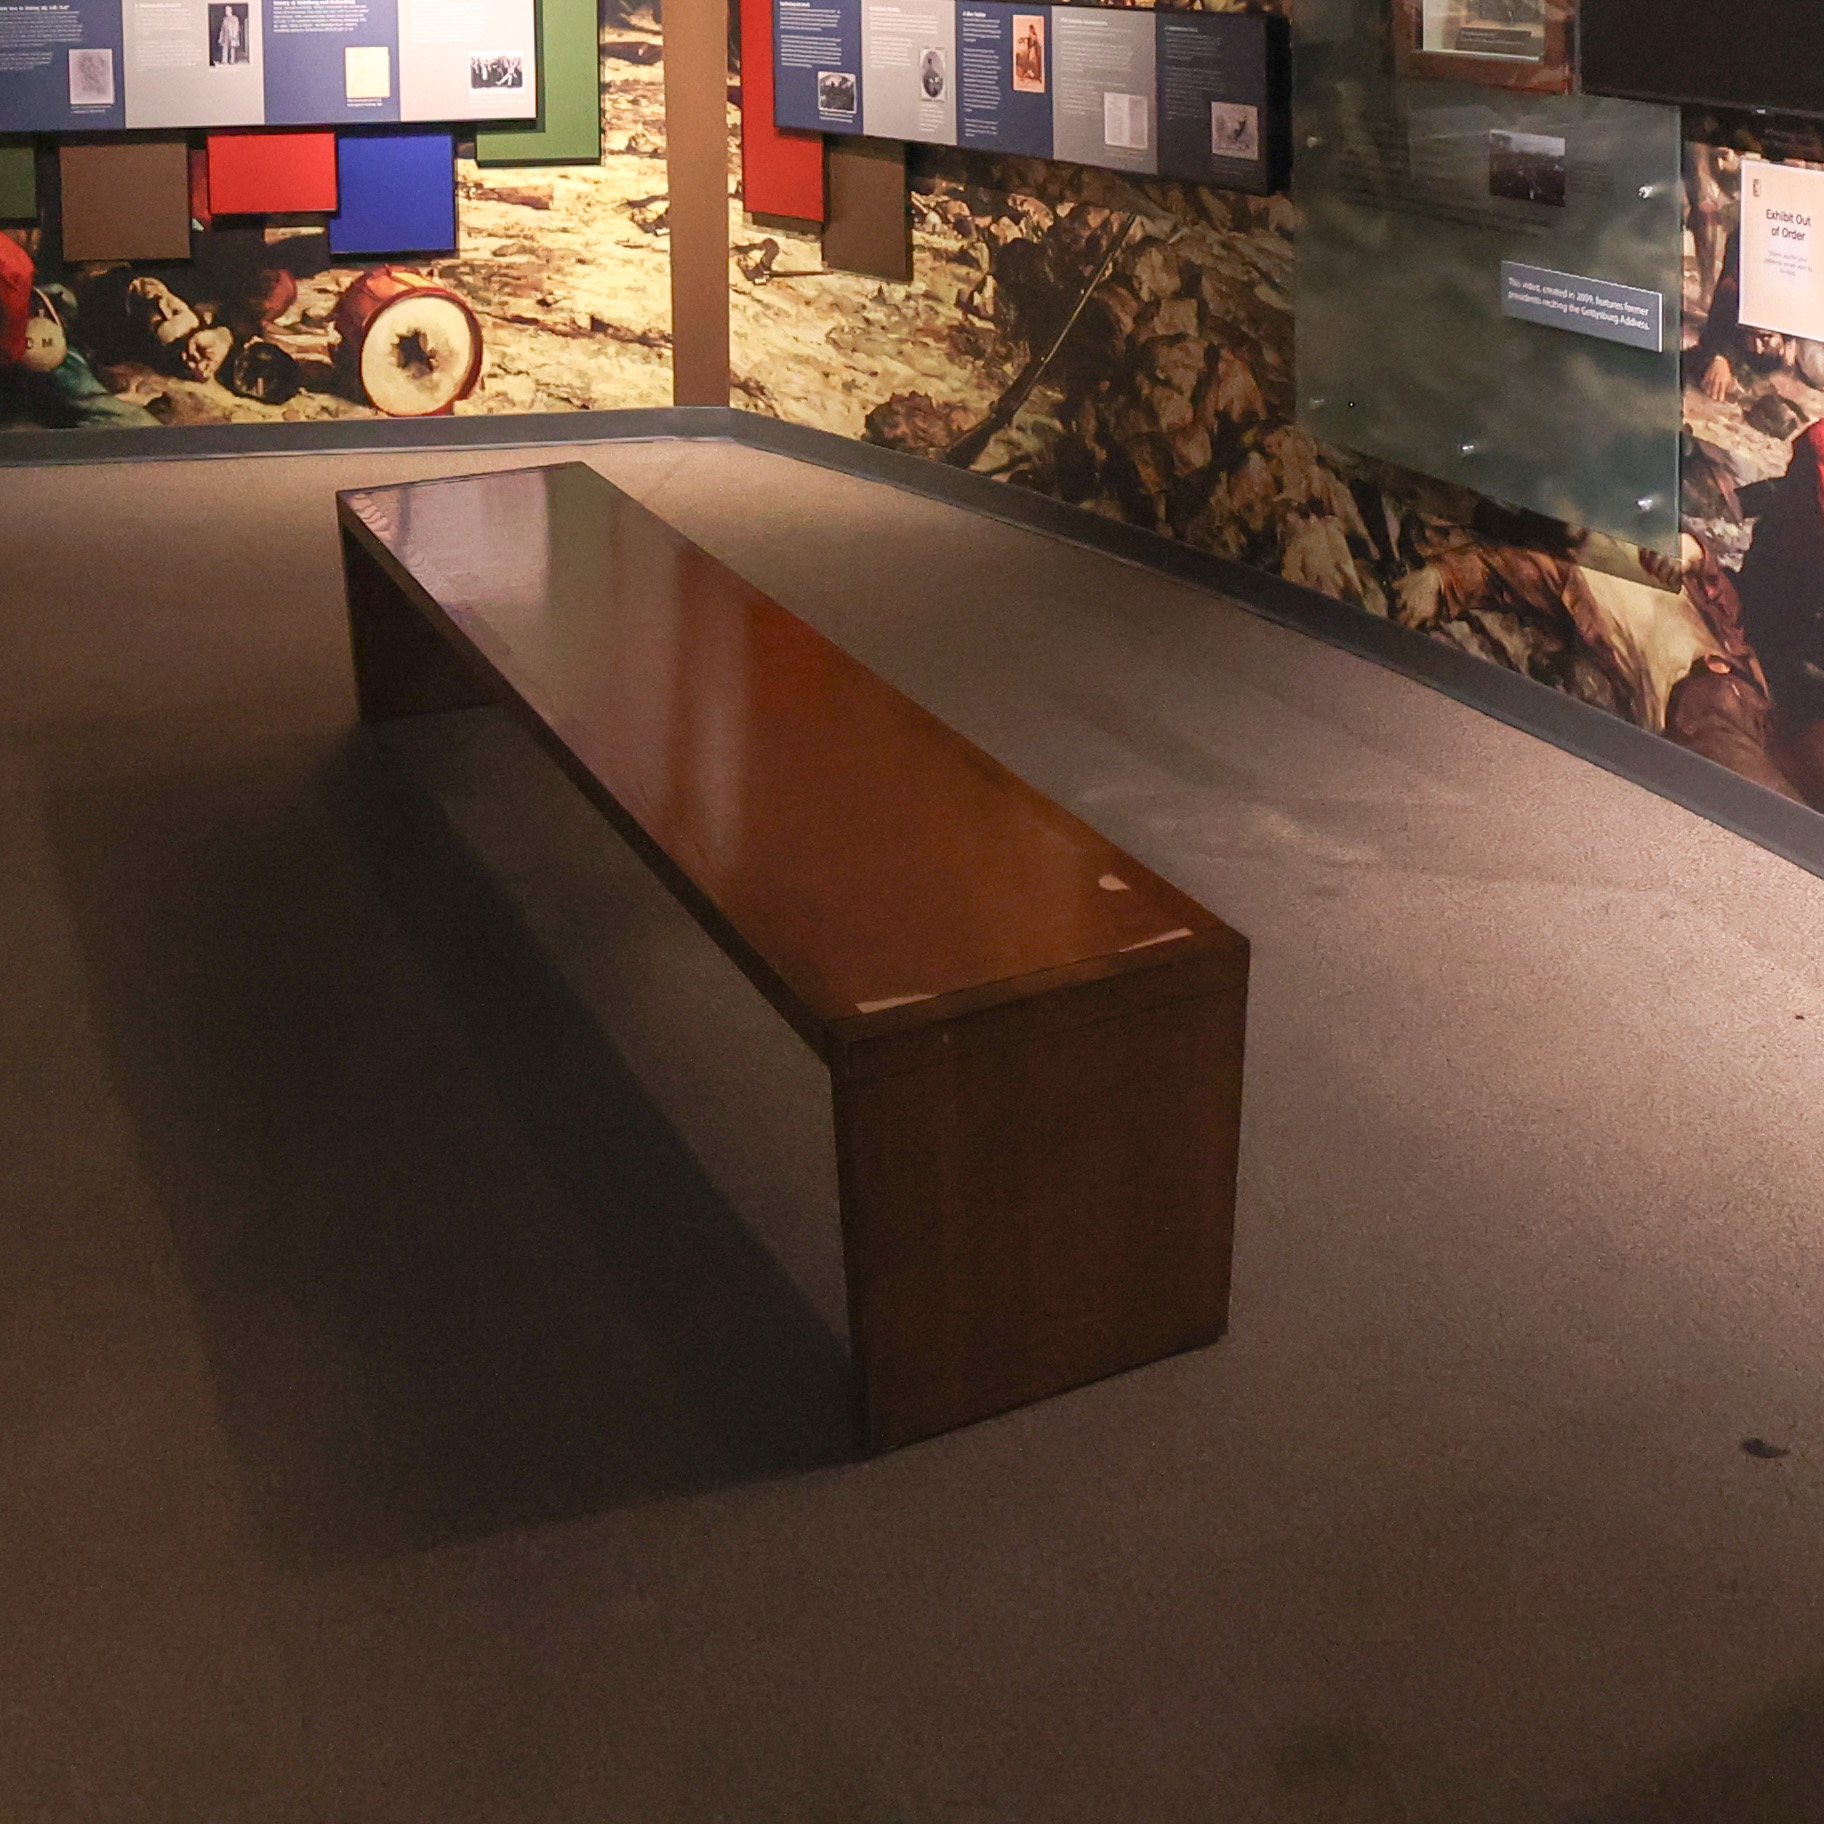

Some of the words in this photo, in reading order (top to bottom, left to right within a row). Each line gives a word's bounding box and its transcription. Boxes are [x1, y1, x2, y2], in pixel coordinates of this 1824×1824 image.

[1766, 208, 1794, 223] Exhibit
[1796, 214, 1811, 227] Out
[1771, 226, 1780, 237] of
[1782, 228, 1805, 241] Order
[1569, 303, 1581, 313] the
[1581, 304, 1619, 325] Gettysburg
[1624, 302, 1649, 316] former
